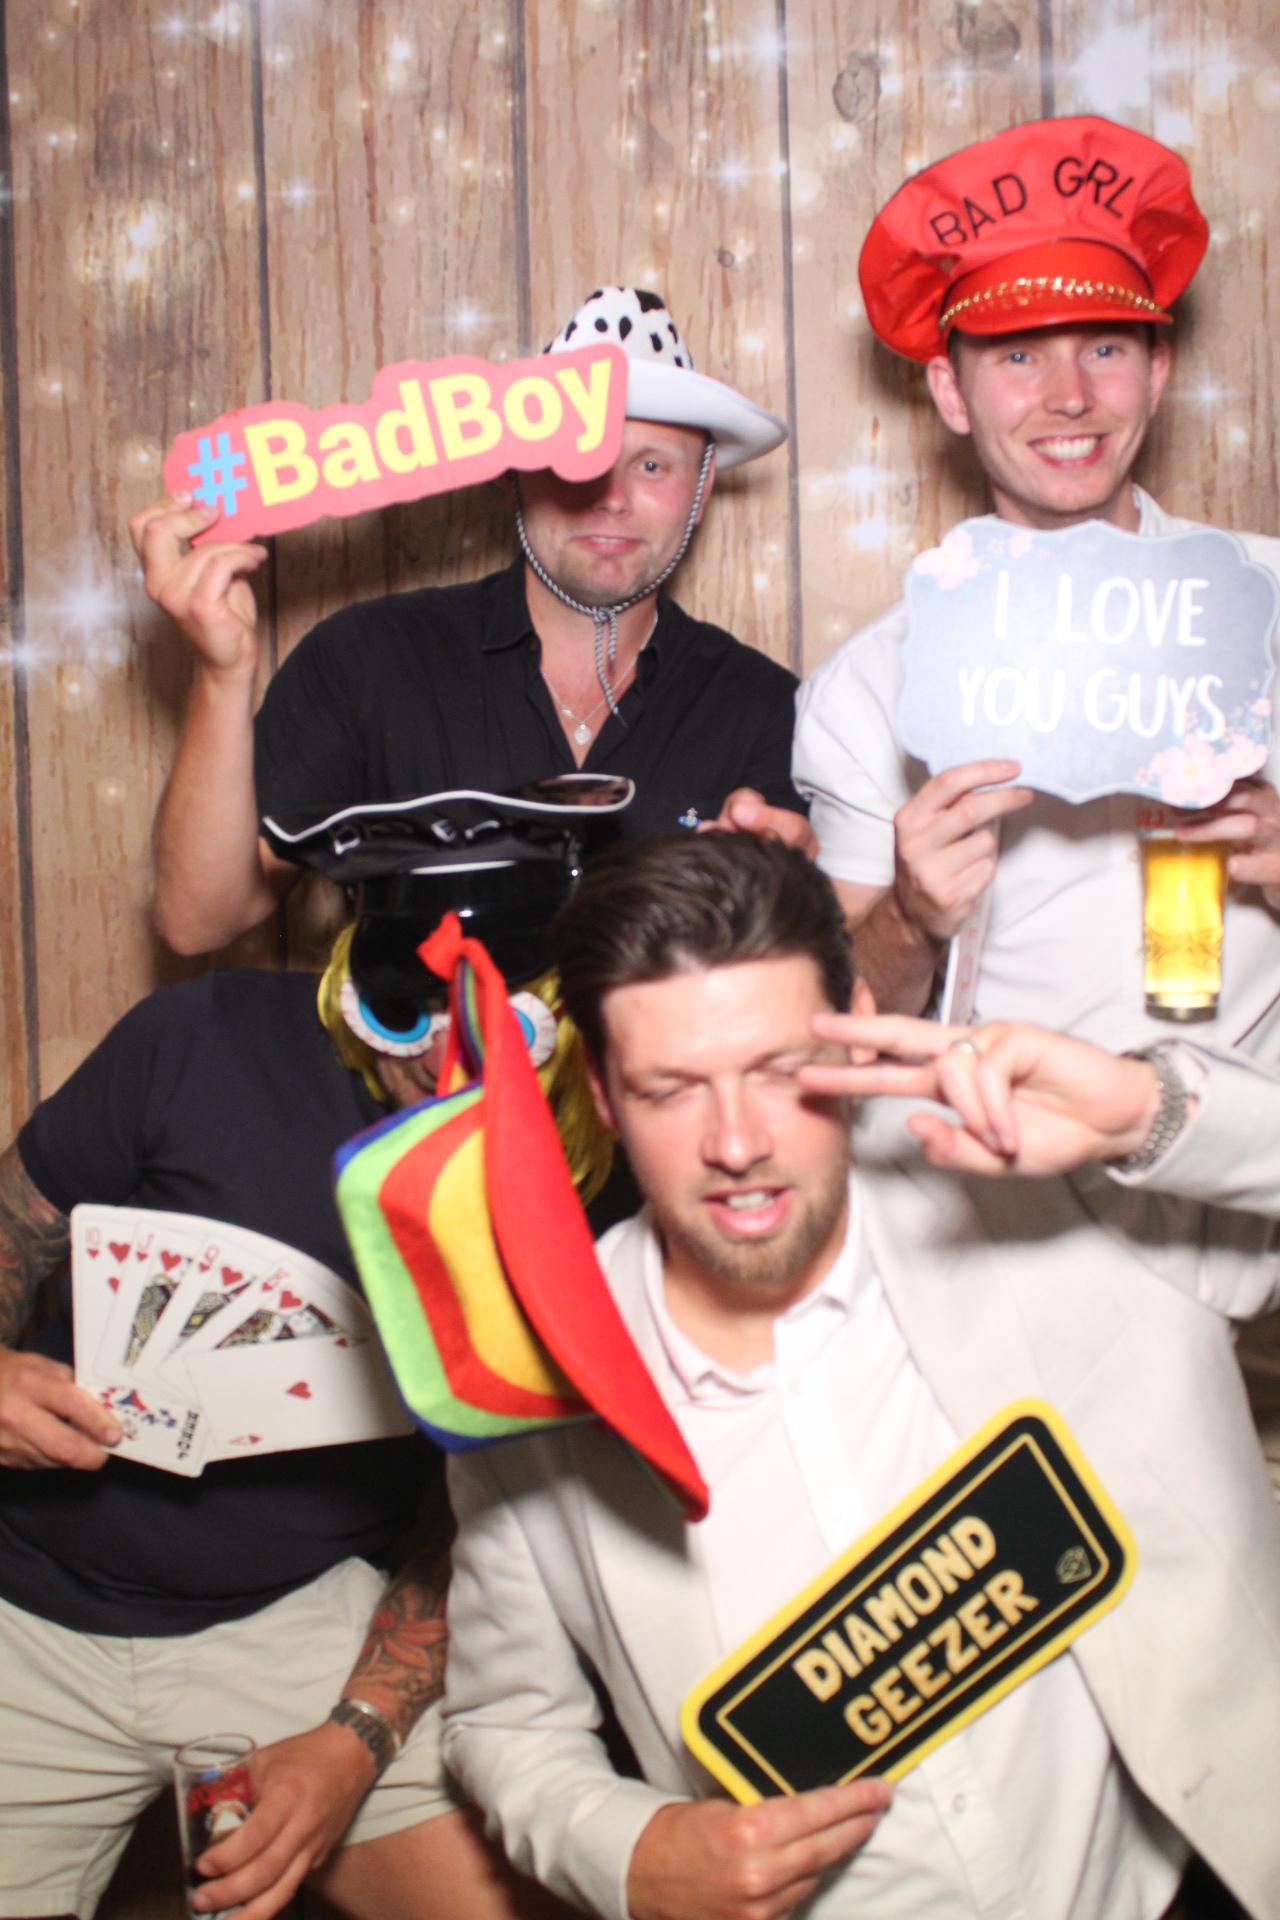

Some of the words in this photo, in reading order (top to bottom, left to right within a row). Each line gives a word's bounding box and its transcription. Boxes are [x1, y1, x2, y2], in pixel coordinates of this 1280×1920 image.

[929, 173, 1028, 246] BAD
[1053, 156, 1134, 219] GRL
[187, 358, 612, 516] #BadBoy
[993, 570, 1010, 639] I
[1056, 573, 1210, 647] LOVE
[957, 665, 1066, 733] YOU
[1083, 668, 1226, 741] GUYS
[793, 1515, 998, 1702] DIAMOND
[842, 1569, 1040, 1746] GEEZER
